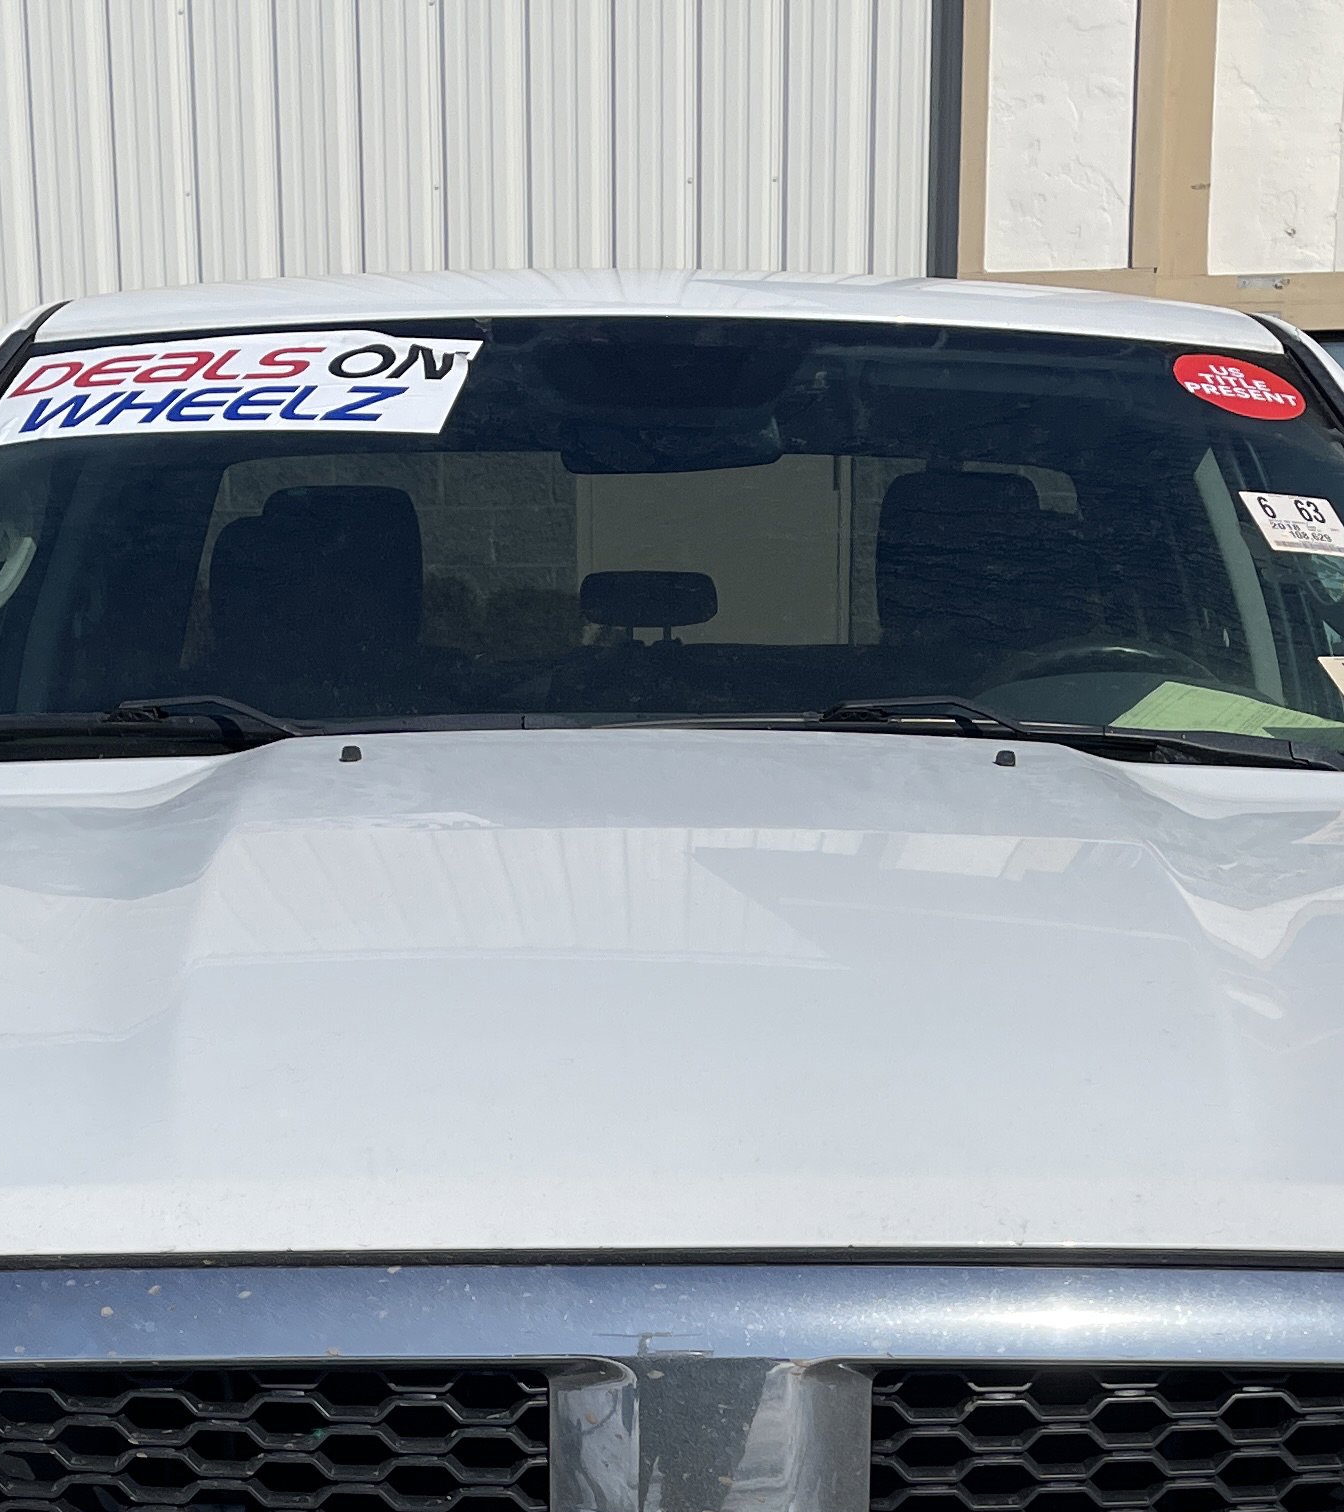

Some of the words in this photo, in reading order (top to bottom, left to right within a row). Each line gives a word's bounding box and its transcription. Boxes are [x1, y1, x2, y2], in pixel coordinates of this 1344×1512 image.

[328, 343, 470, 381] ON
[1208, 364, 1245, 378] US
[1183, 381, 1297, 407] PRESENT
[1198, 372, 1271, 392] TITLE
[18, 384, 409, 433] WHEELZ
[1257, 496, 1276, 519] 6
[1294, 499, 1326, 524] 63
